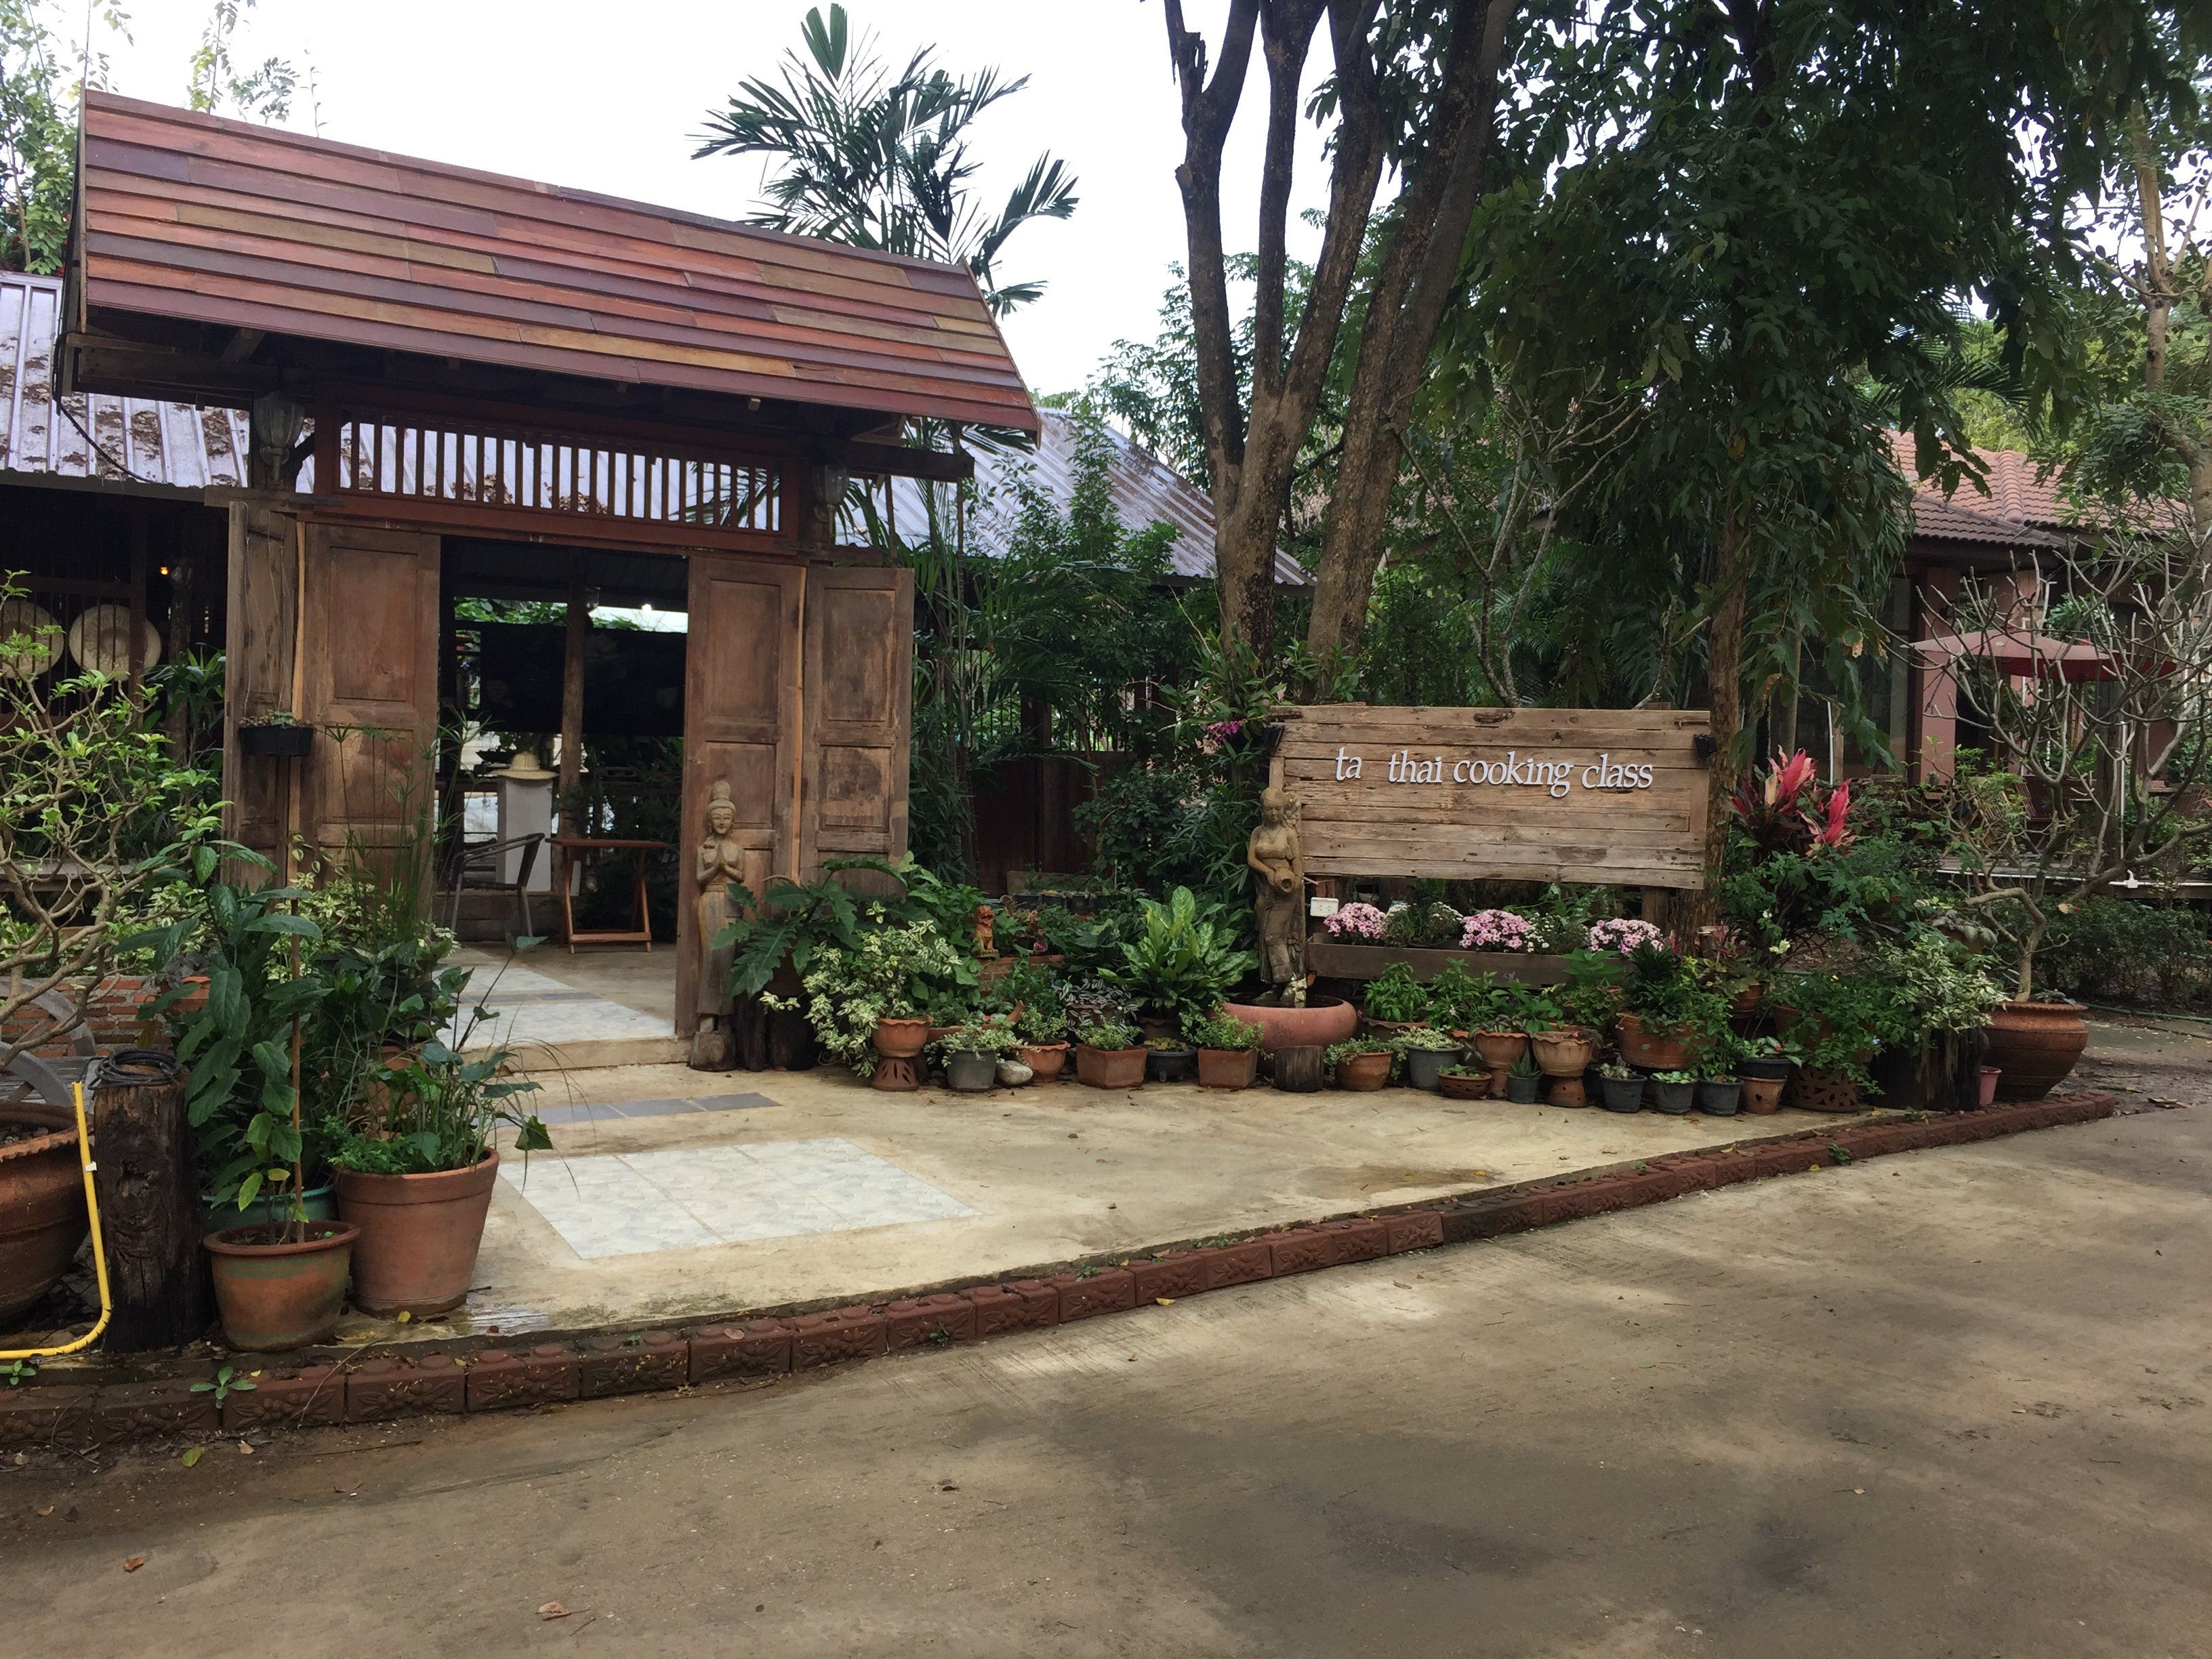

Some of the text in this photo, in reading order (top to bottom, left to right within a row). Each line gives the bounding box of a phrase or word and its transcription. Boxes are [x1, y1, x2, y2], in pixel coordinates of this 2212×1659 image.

[1335, 746, 1654, 798] ta thai cooking class
